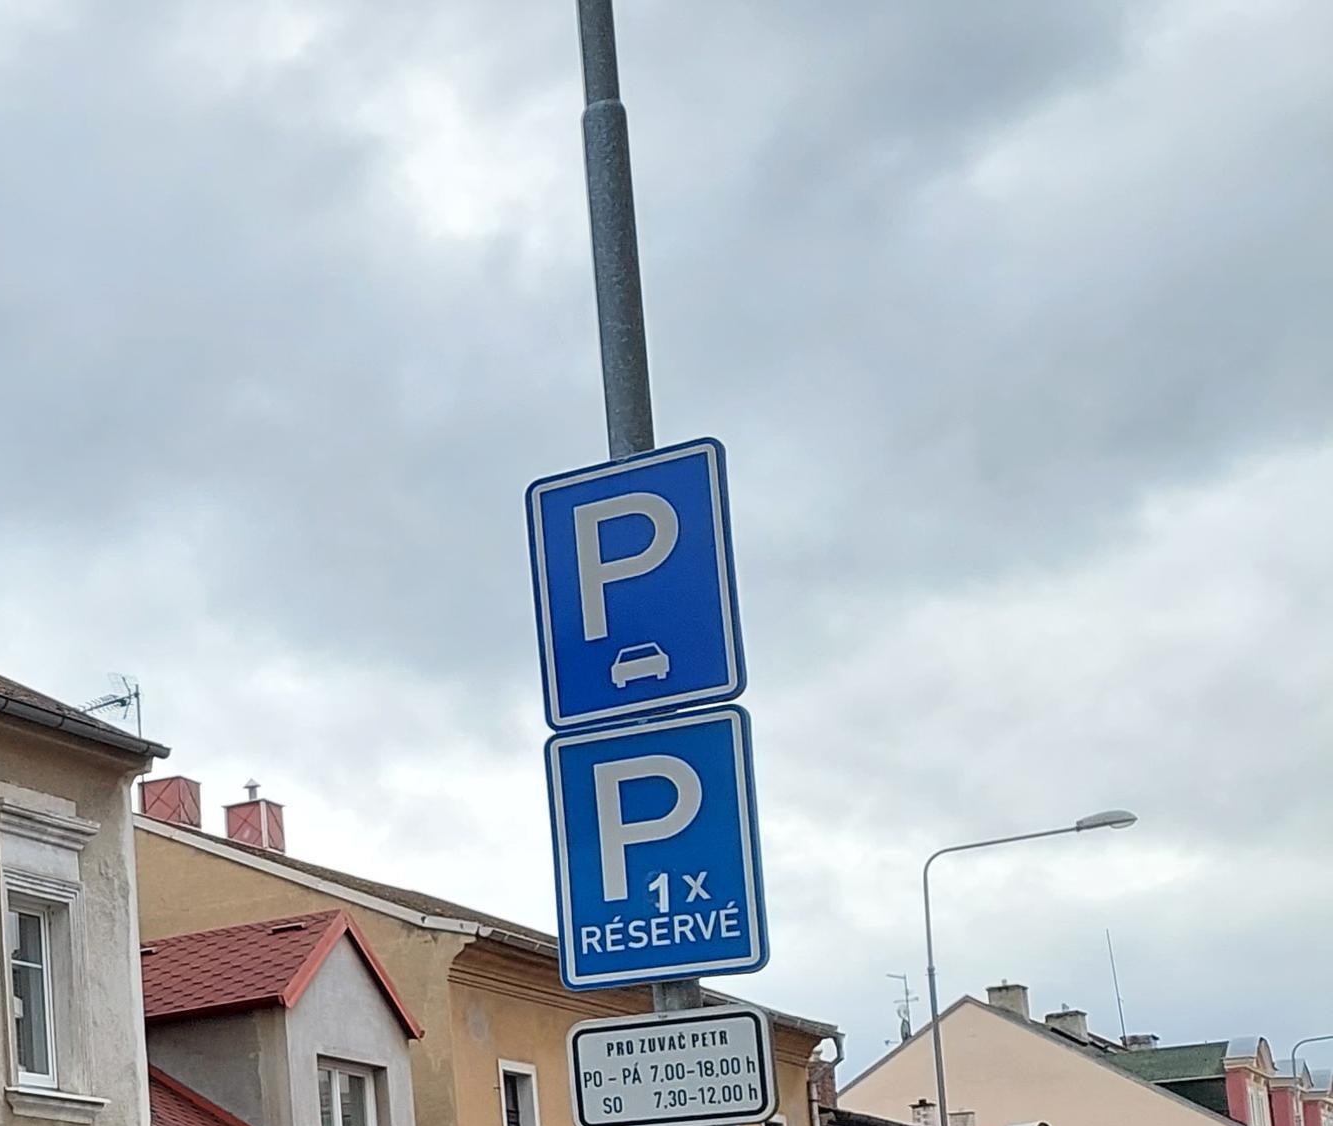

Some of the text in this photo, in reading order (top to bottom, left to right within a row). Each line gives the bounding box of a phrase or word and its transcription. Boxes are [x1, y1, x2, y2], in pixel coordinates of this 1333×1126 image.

[574, 491, 679, 642] P
[593, 755, 702, 902] P
[581, 902, 741, 955] RÉSERVÉ
[606, 1030, 729, 1057] PRO ZUVAČ PETR
[583, 1070, 603, 1088] PO
[622, 1062, 642, 1085] PÁ
[746, 1055, 756, 1073] h
[603, 1096, 623, 1114] SO
[748, 1083, 758, 1100] h
